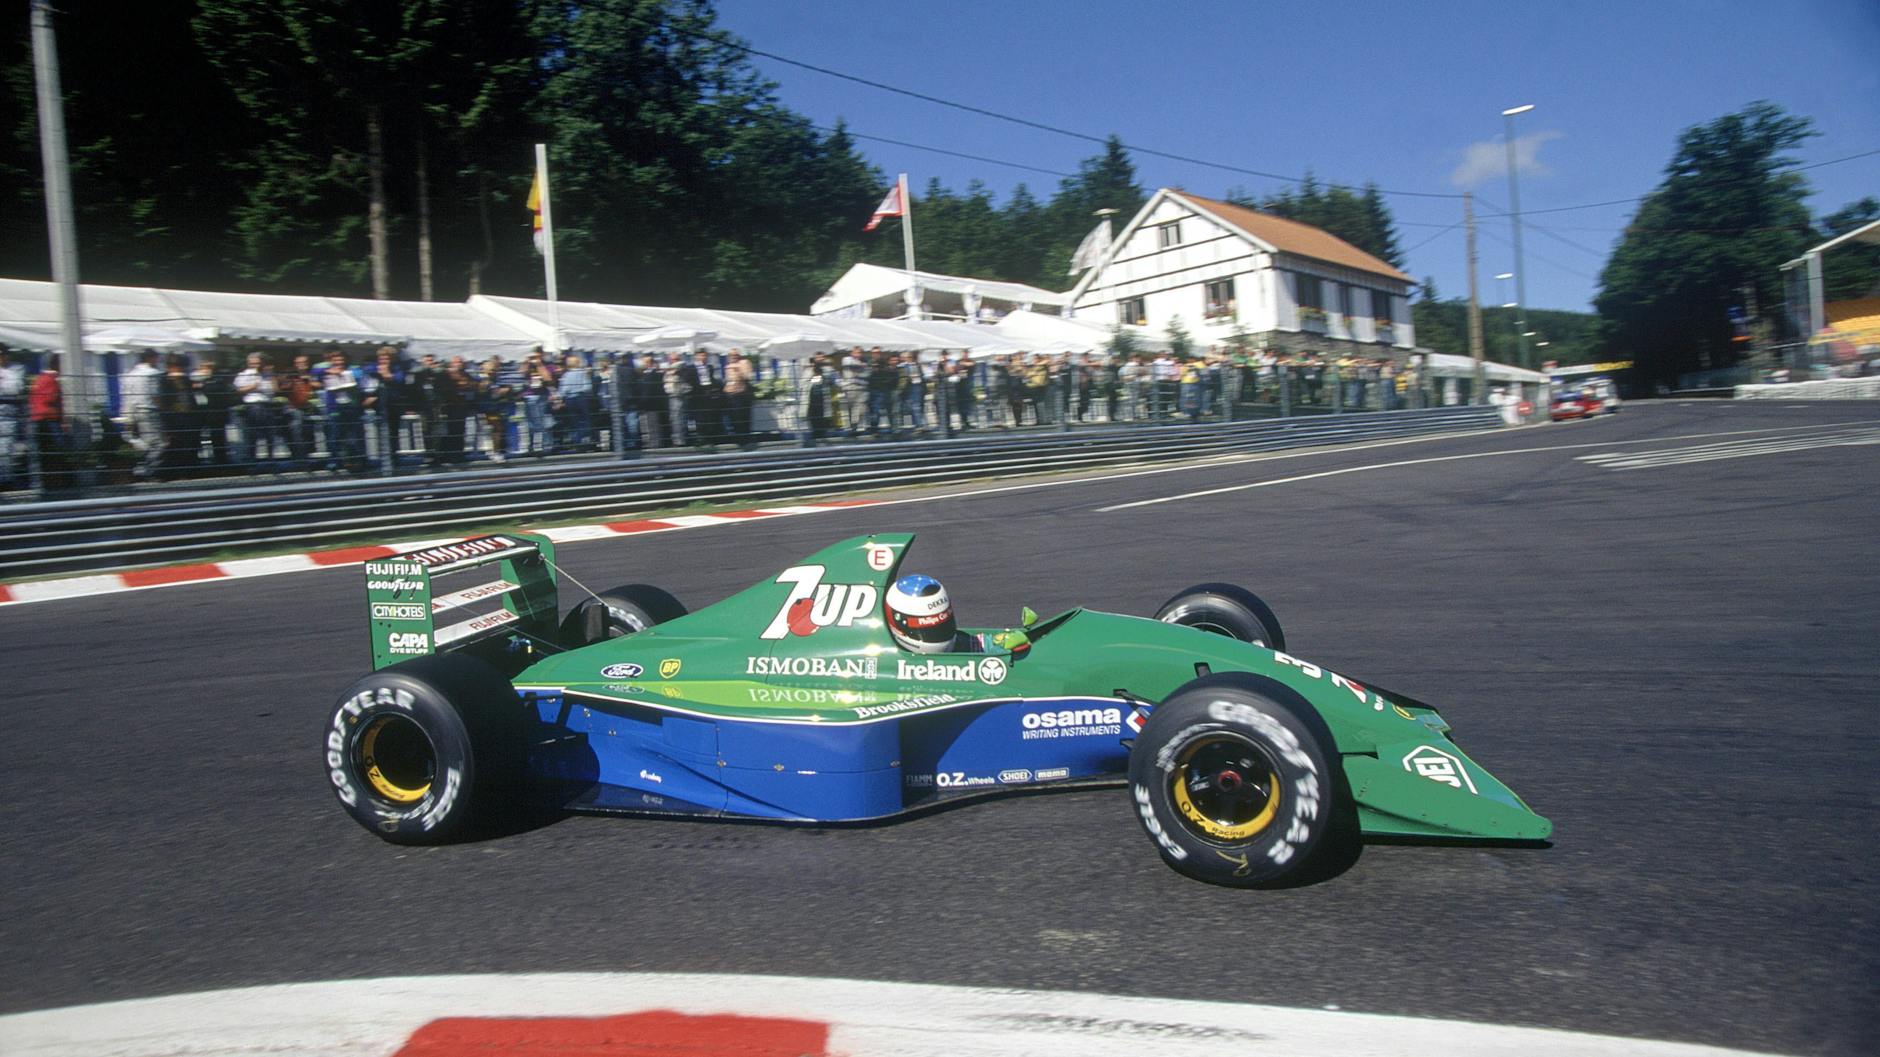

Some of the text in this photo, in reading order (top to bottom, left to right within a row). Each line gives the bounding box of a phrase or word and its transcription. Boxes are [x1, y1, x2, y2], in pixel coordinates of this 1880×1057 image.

[874, 549, 886, 566] E
[365, 563, 422, 576] FUJIFILM
[367, 579, 424, 592] GOODYEAR
[389, 632, 428, 648] CAPA
[607, 664, 637, 678] Ford
[662, 662, 679, 674] BP
[746, 657, 866, 677] ISMOBAN
[897, 659, 976, 681] Ireland
[853, 693, 956, 720] Brooksfield
[1022, 708, 1121, 729] osama
[1022, 724, 1121, 740] WRITING INSTRUMENTS
[1002, 770, 1028, 782] SHOEI
